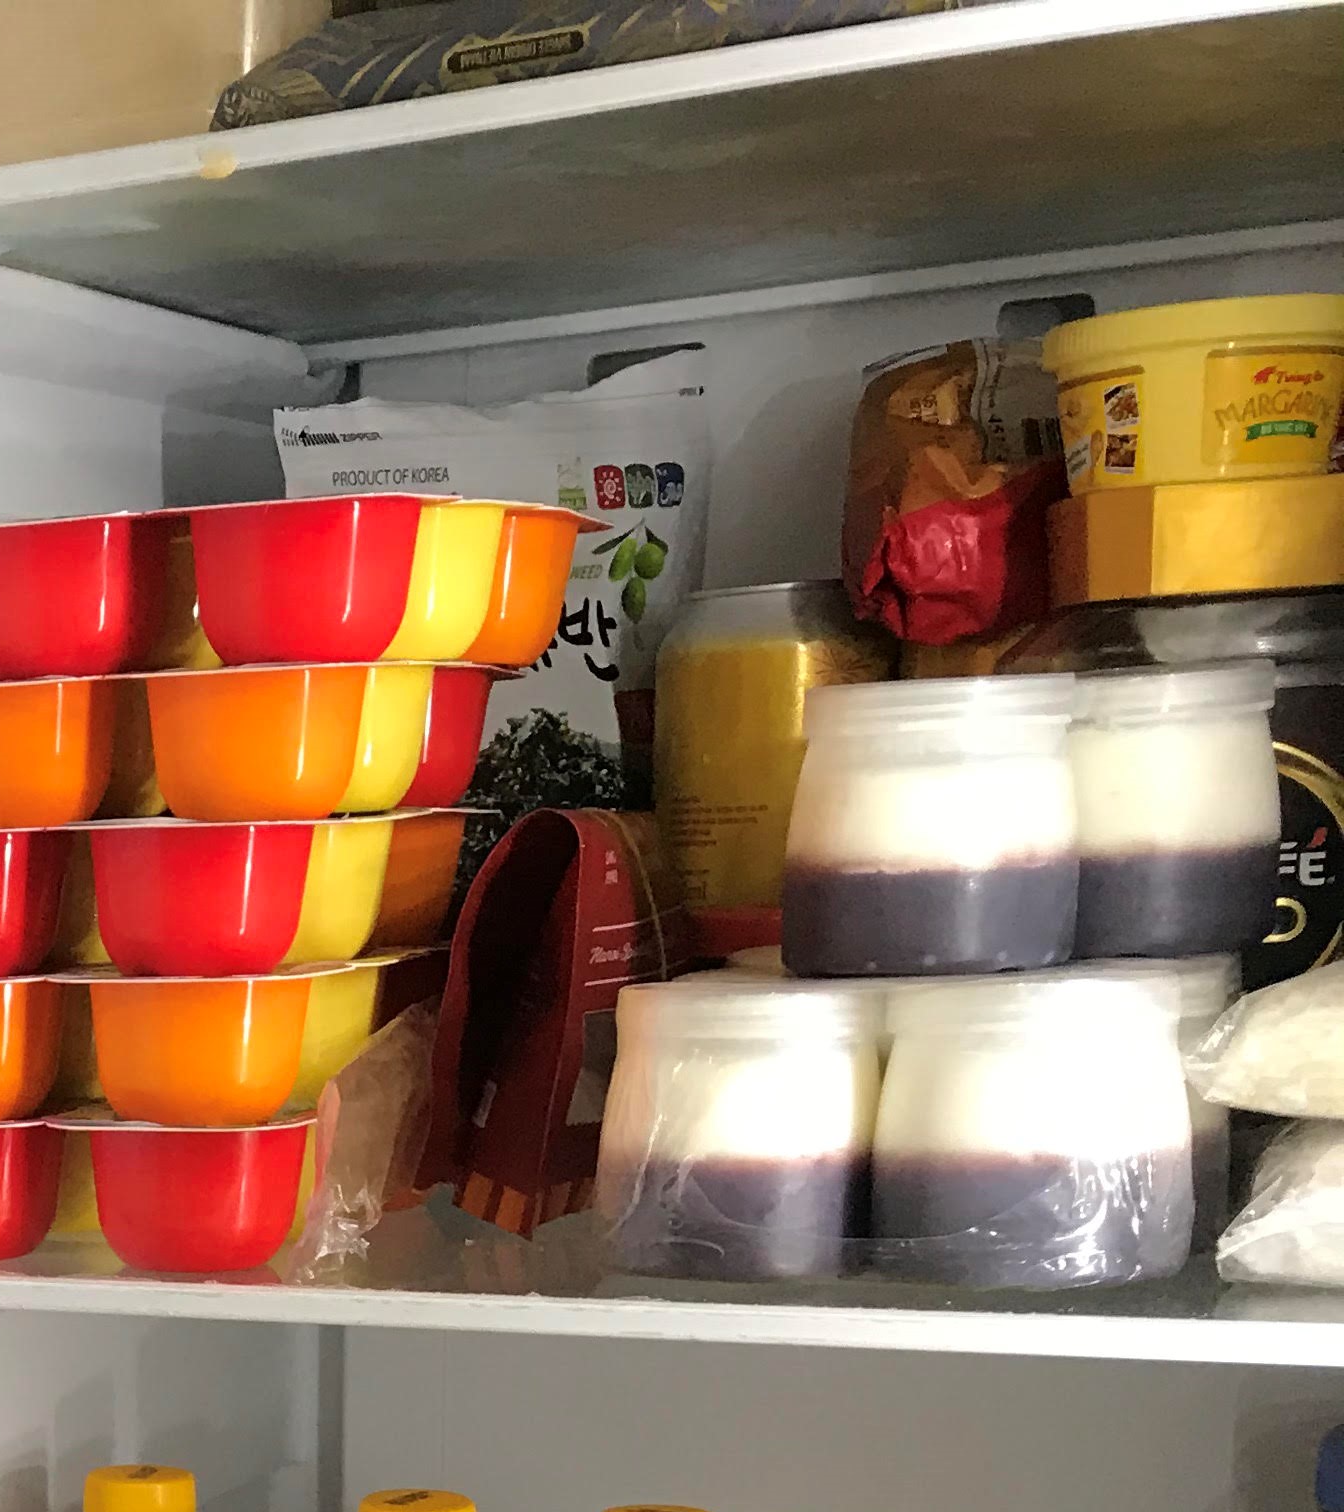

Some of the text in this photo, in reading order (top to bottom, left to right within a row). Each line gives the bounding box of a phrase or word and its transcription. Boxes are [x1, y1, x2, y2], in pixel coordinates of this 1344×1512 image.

[332, 467, 450, 487] PRODUCT OF KOREA
